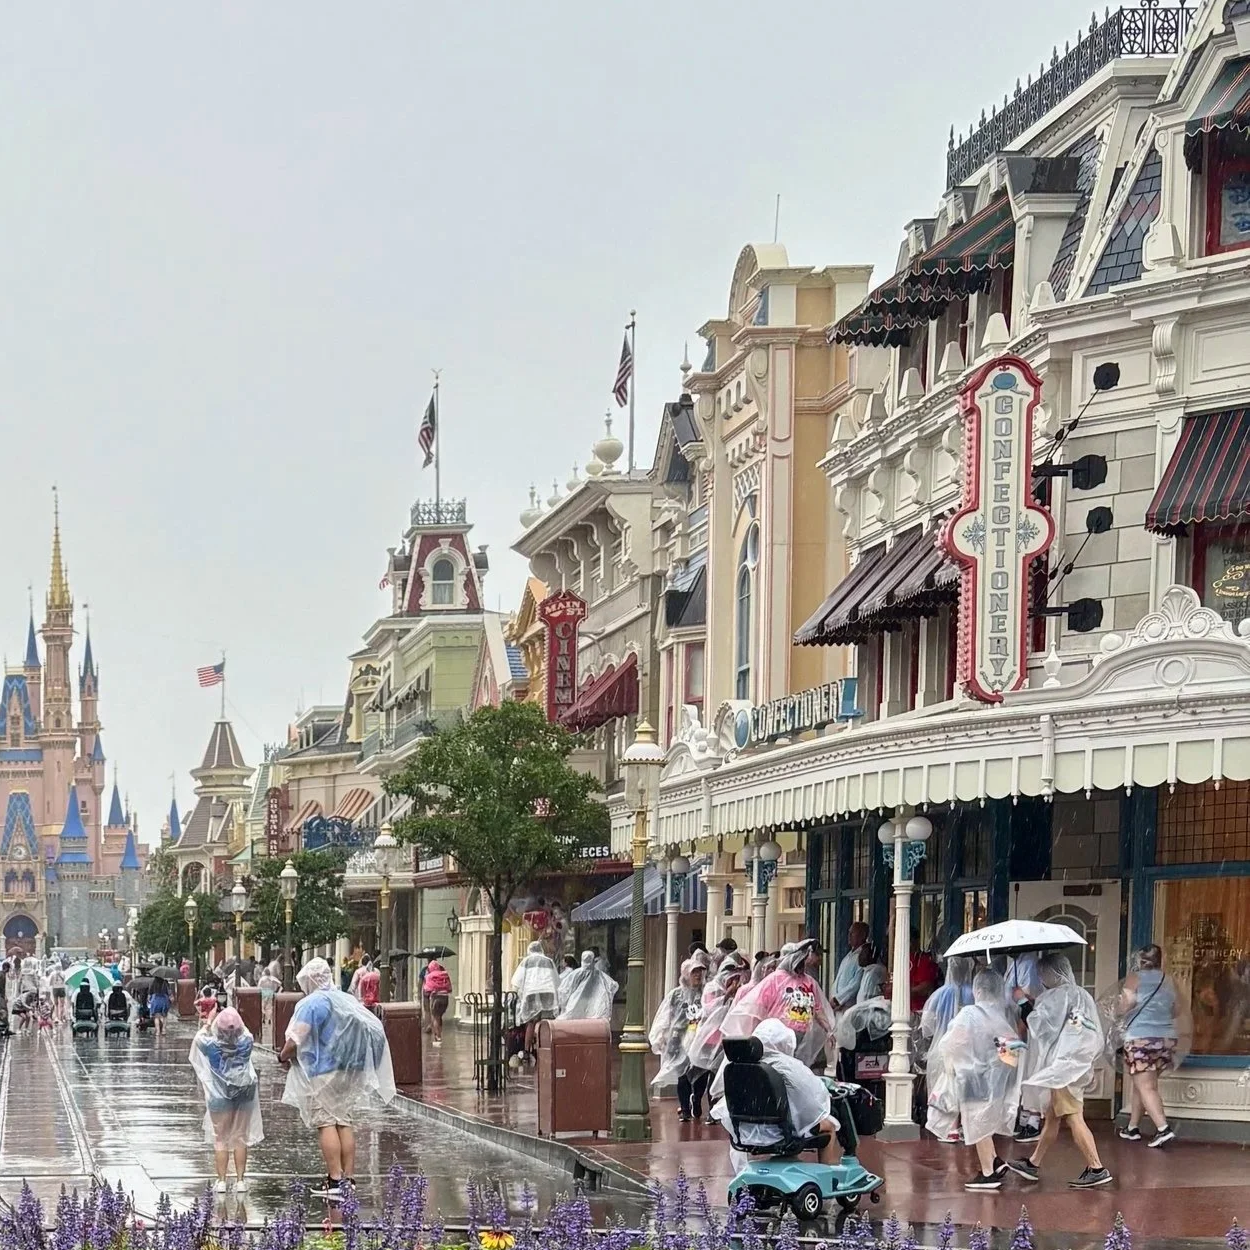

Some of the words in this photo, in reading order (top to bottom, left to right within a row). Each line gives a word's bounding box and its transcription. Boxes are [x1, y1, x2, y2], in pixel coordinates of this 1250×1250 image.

[988, 395, 1014, 677] CONFECTIONERY
[545, 601, 581, 615] MAIN
[751, 679, 844, 742] CONFECTIONERY
